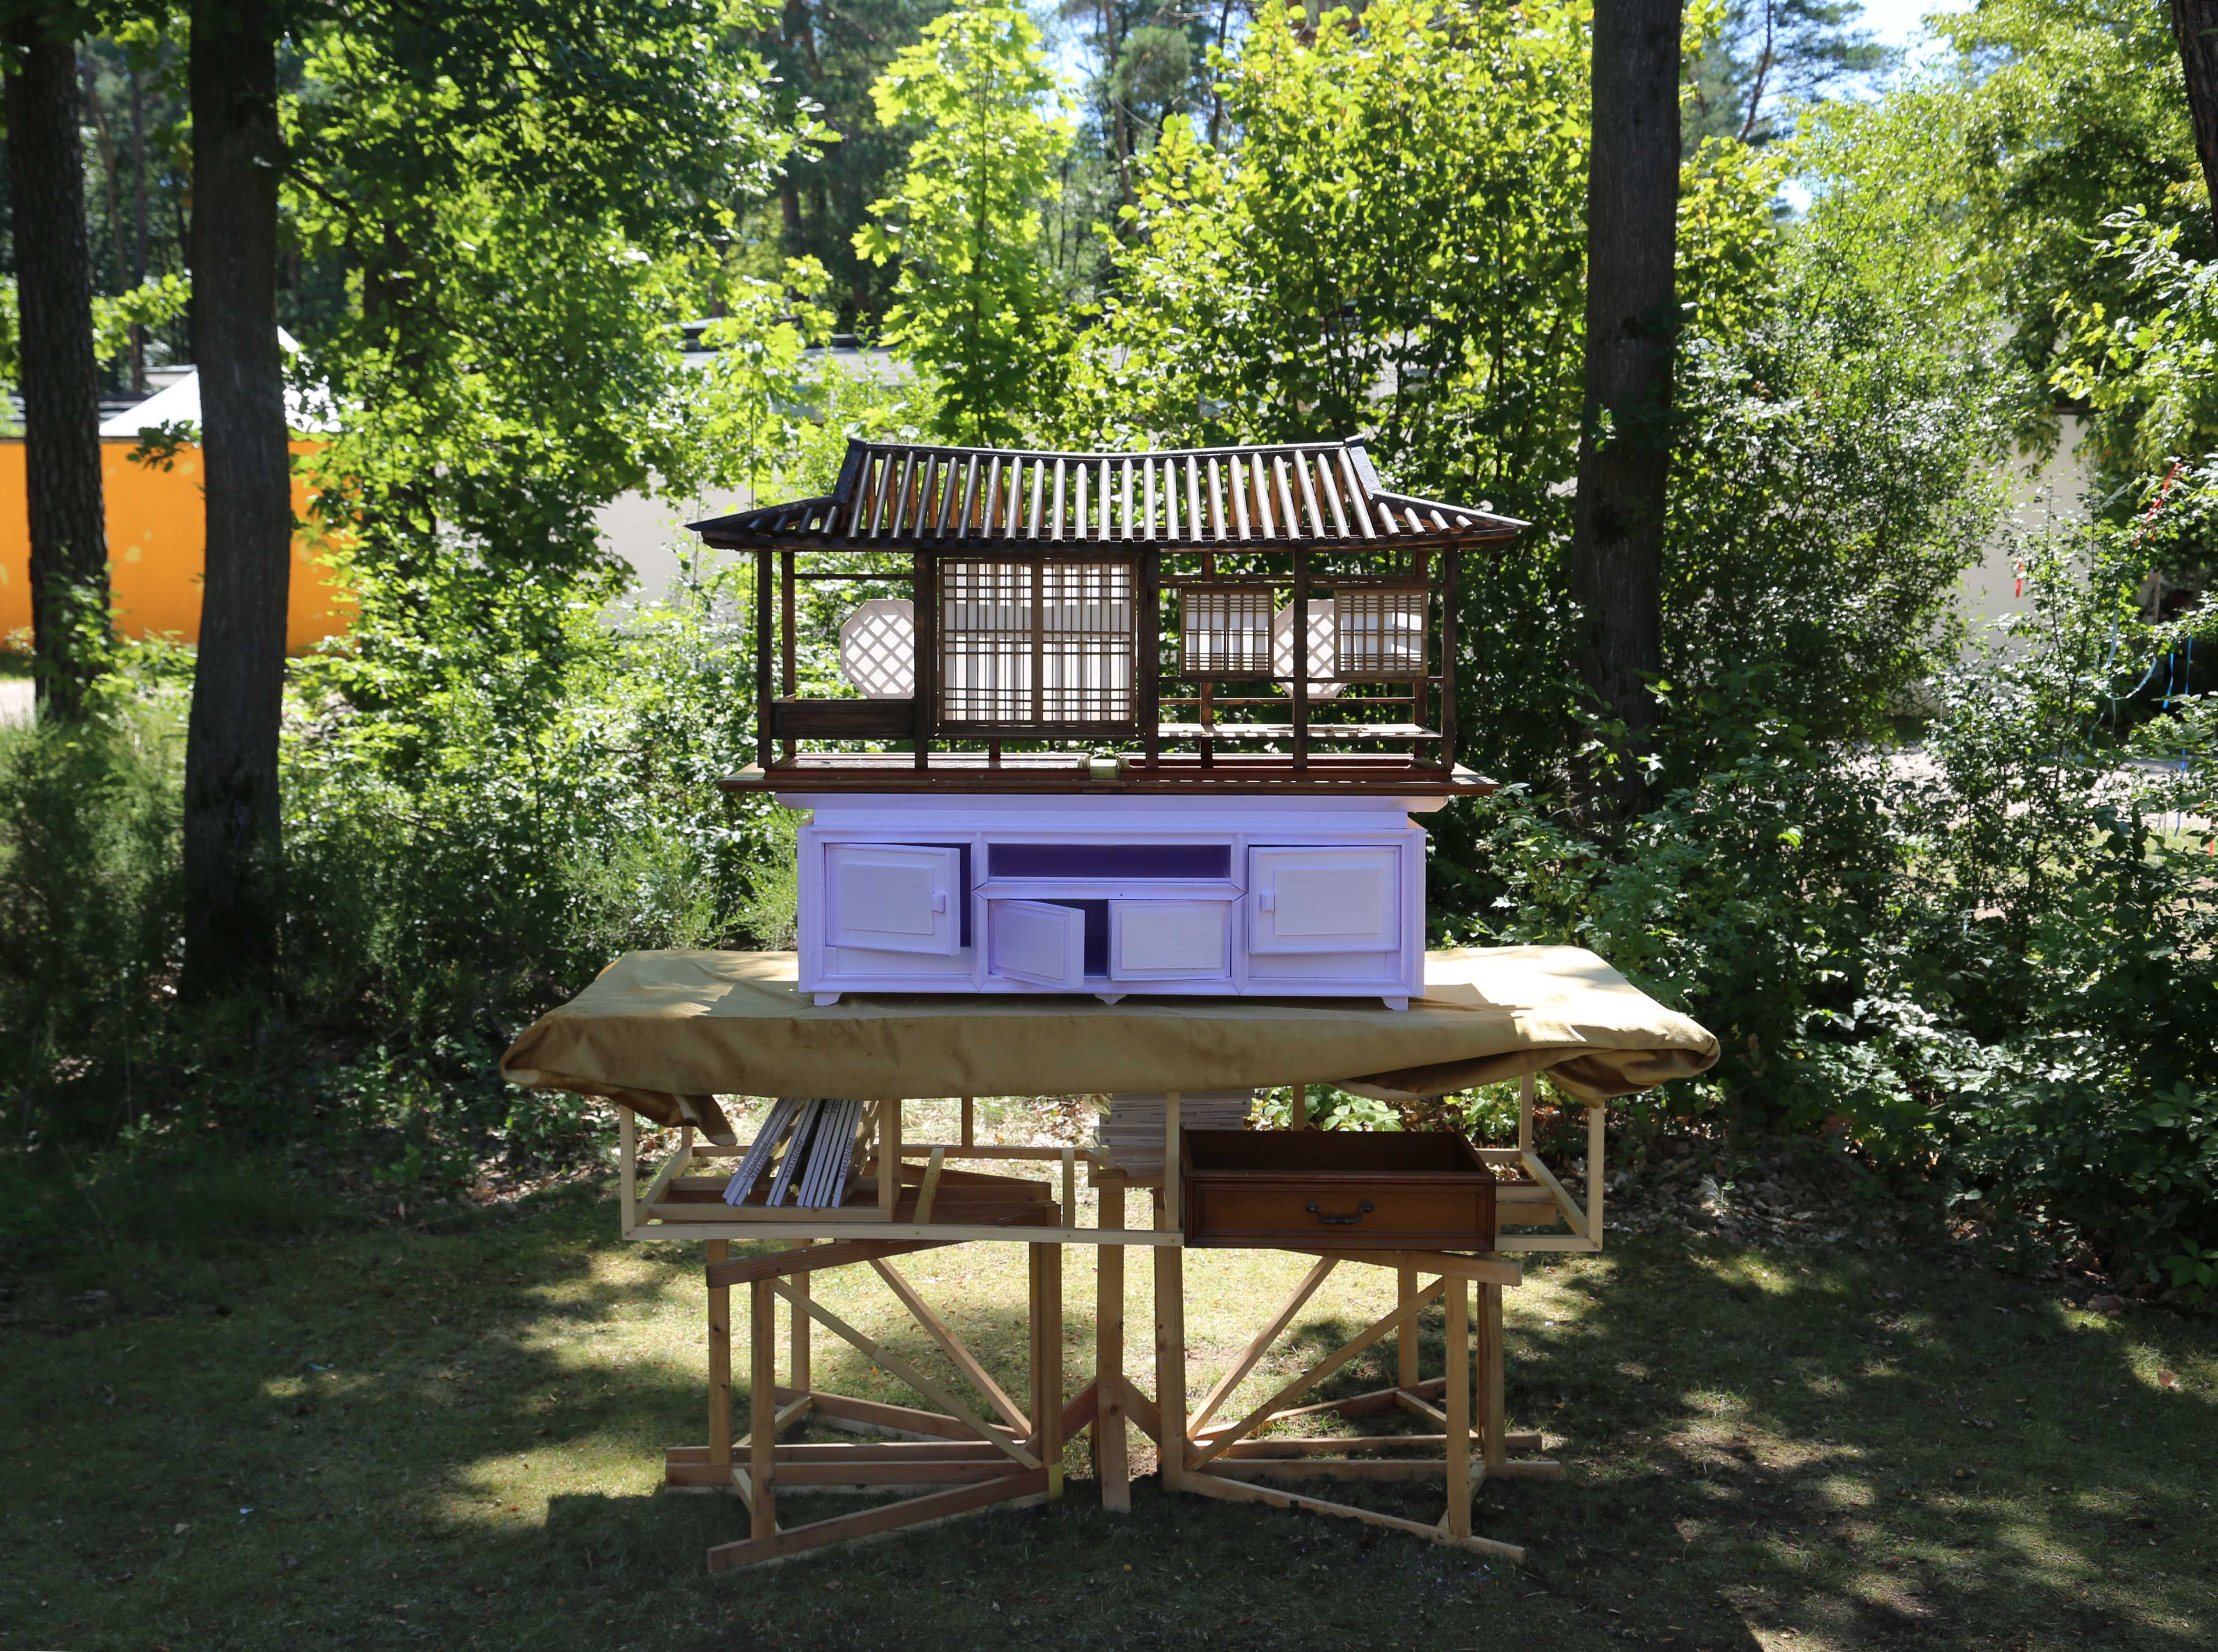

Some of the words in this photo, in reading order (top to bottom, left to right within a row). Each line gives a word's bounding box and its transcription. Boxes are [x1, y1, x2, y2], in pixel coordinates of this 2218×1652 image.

[742, 1142, 766, 1180] PROTOTYPEN
[750, 1142, 774, 1180] PROTOTYPEN
[784, 1140, 804, 1179] PROTOTYPEN
[839, 1137, 854, 1179] PROTOTYPEN
